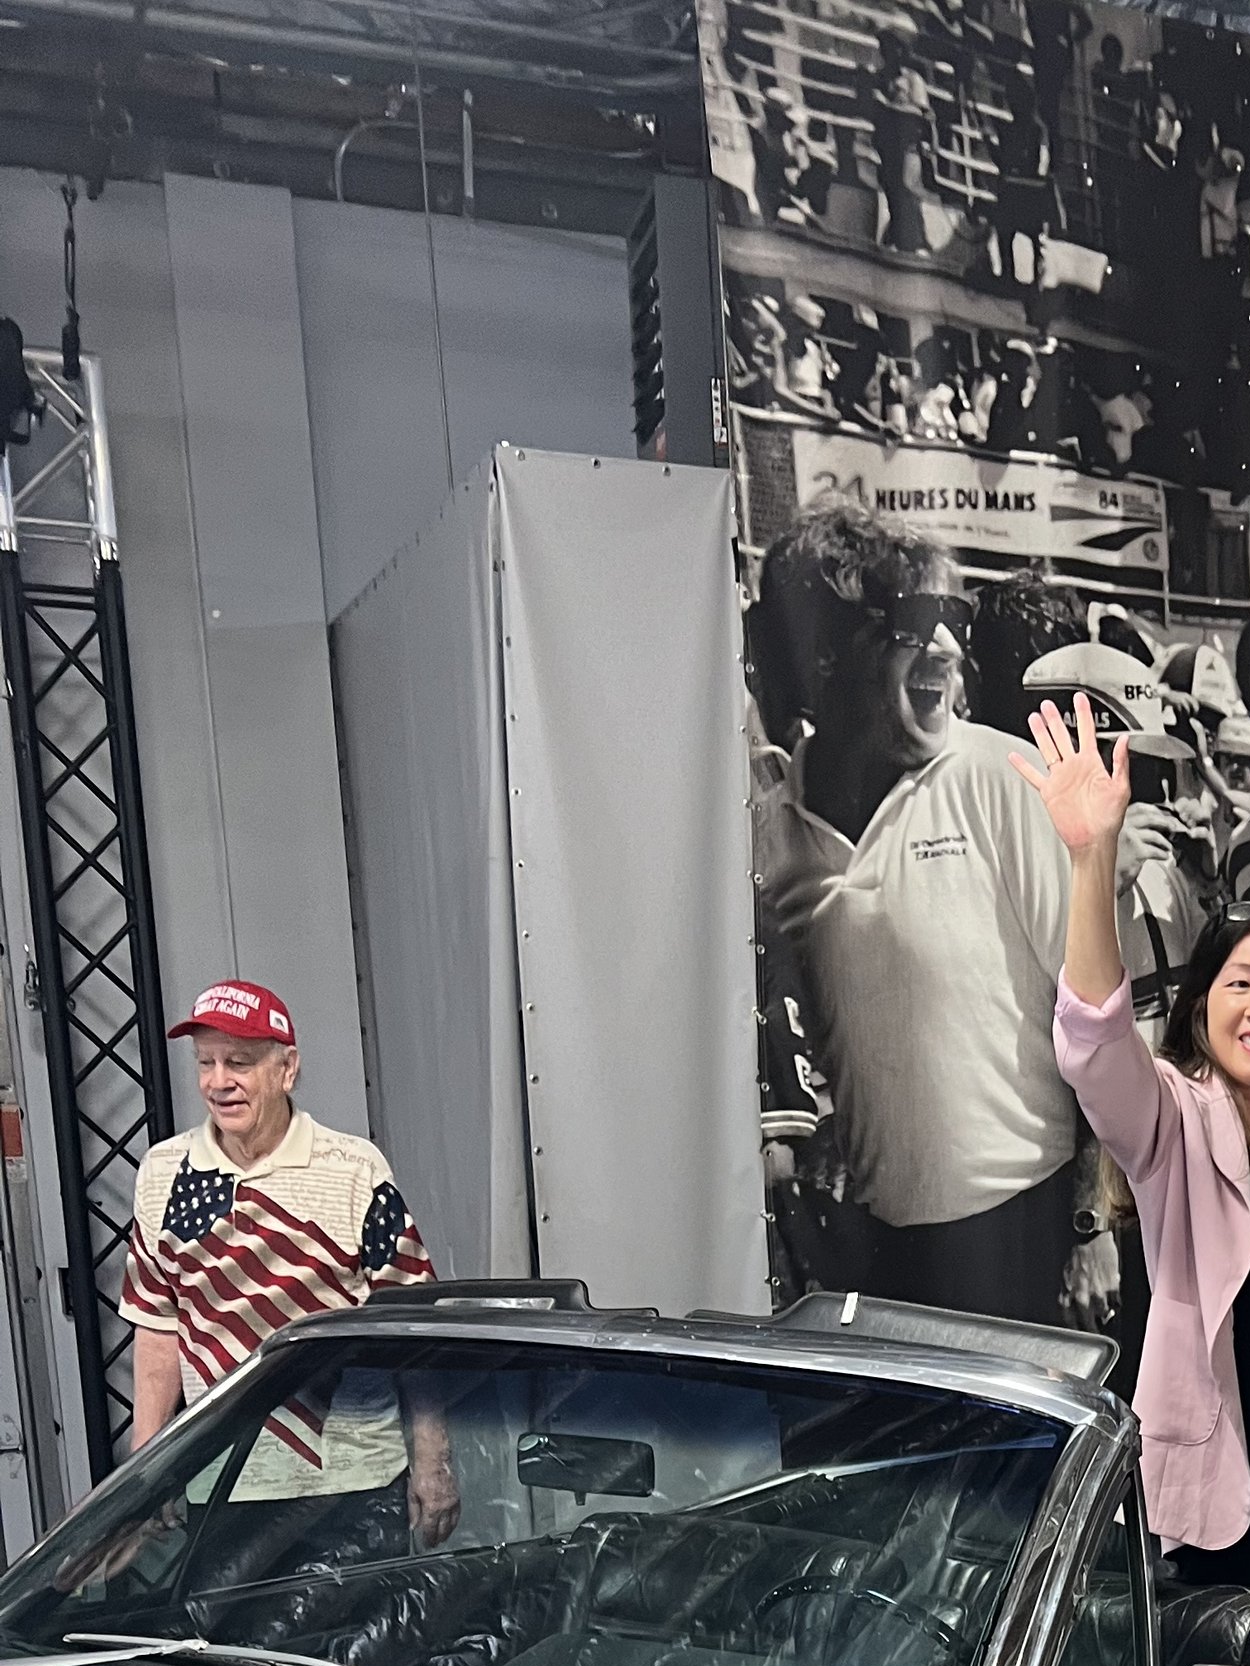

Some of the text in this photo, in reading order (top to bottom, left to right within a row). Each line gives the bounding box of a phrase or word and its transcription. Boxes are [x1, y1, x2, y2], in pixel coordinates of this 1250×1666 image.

[875, 486, 949, 511] HEURES
[954, 487, 979, 511] DU
[984, 487, 1036, 512] MANS
[215, 1000, 251, 1021] AGAIN
